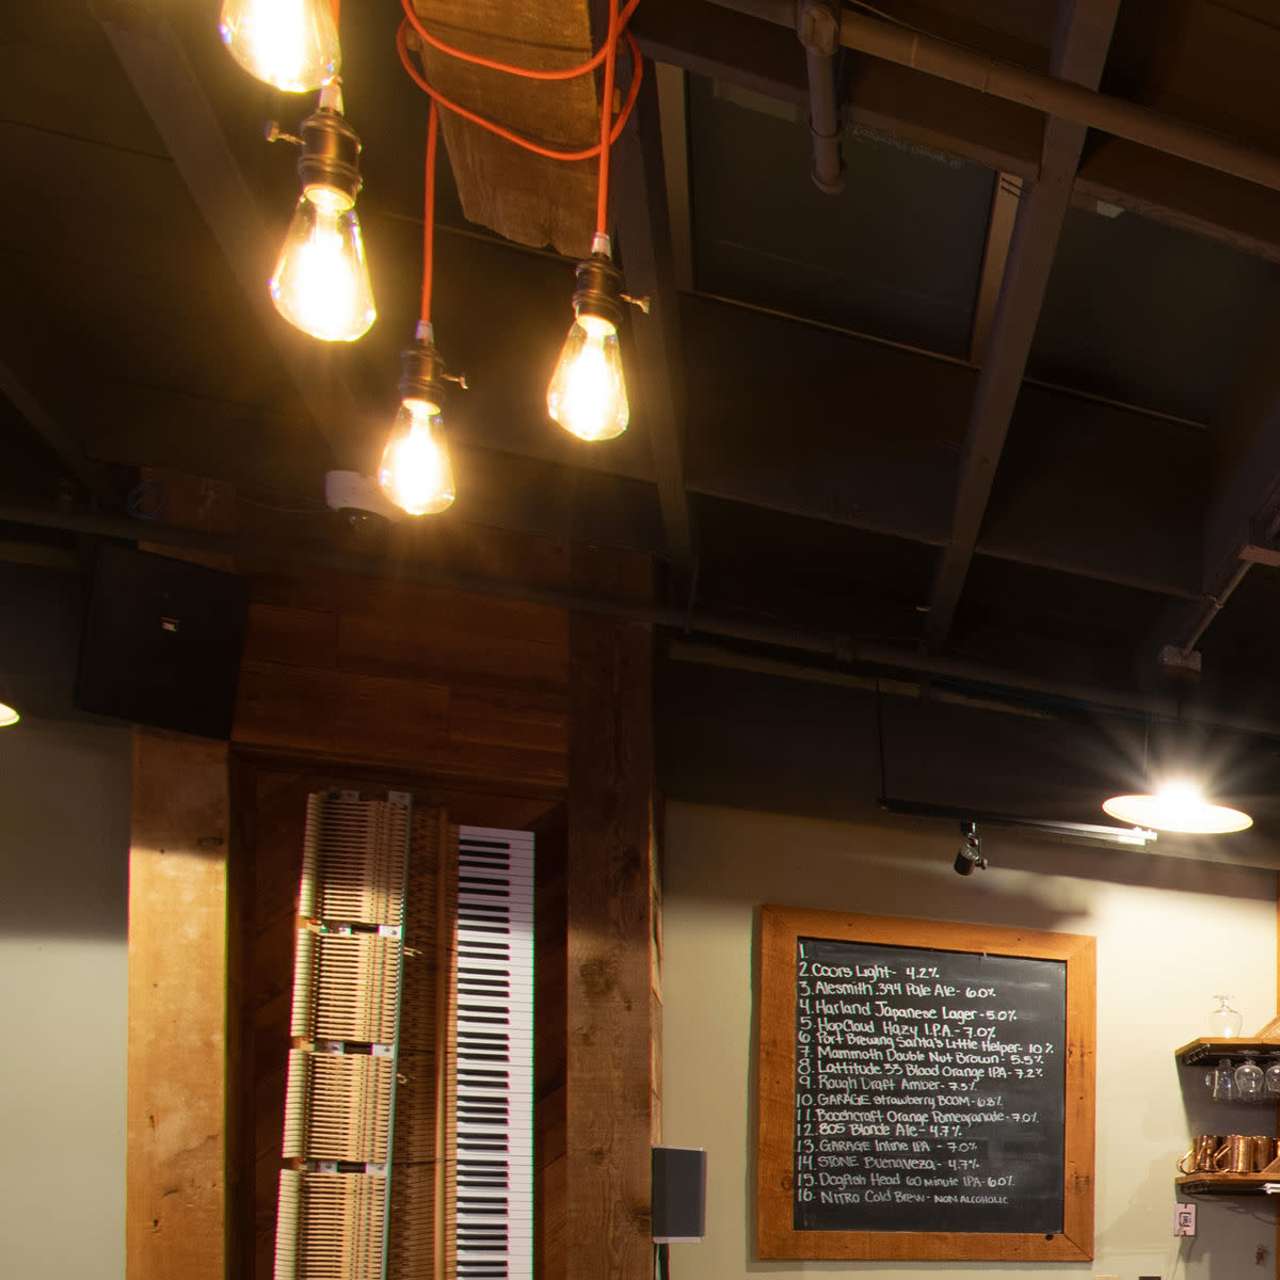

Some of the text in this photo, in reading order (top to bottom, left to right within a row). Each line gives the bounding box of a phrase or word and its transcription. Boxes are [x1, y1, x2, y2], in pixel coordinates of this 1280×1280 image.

[811, 963, 853, 977] Coors
[906, 967, 940, 980] 4.2%
[815, 981, 873, 995] Alesmith
[906, 983, 931, 997] Pale
[815, 999, 871, 1016] Harland
[874, 1001, 938, 1021] Japanese
[942, 1006, 978, 1025] Lager
[883, 1020, 918, 1037] Hazy
[816, 1032, 844, 1044] Port
[846, 1033, 895, 1049] Brewing
[896, 1035, 943, 1048] Santa's
[945, 1039, 978, 1050] Little
[817, 1046, 883, 1060] Mammoth
[886, 1048, 925, 1062] Double
[928, 1051, 953, 1063] Nut
[817, 1061, 882, 1075] Lattitude
[905, 1064, 939, 1077] Blood
[942, 1066, 985, 1082] Orange
[819, 1074, 858, 1095] Rough
[861, 1077, 896, 1090] Draft
[817, 1094, 872, 1106] GARAGE
[873, 1095, 935, 1109] strawberry
[886, 1110, 929, 1126] Orange
[819, 1123, 846, 1135] 805
[849, 1123, 890, 1136] Blonde
[930, 1125, 962, 1137] 4.7%
[819, 1140, 871, 1152] GARAGE
[817, 1155, 859, 1168] STONE
[948, 1158, 980, 1170] 4.7%
[820, 1172, 866, 1190] Dogfish
[870, 1173, 900, 1185] Head
[821, 1191, 860, 1204] NITRO
[864, 1188, 892, 1202] Cold
[934, 1195, 957, 1204] NON
[960, 1195, 1009, 1204] ALCOHOLIC
